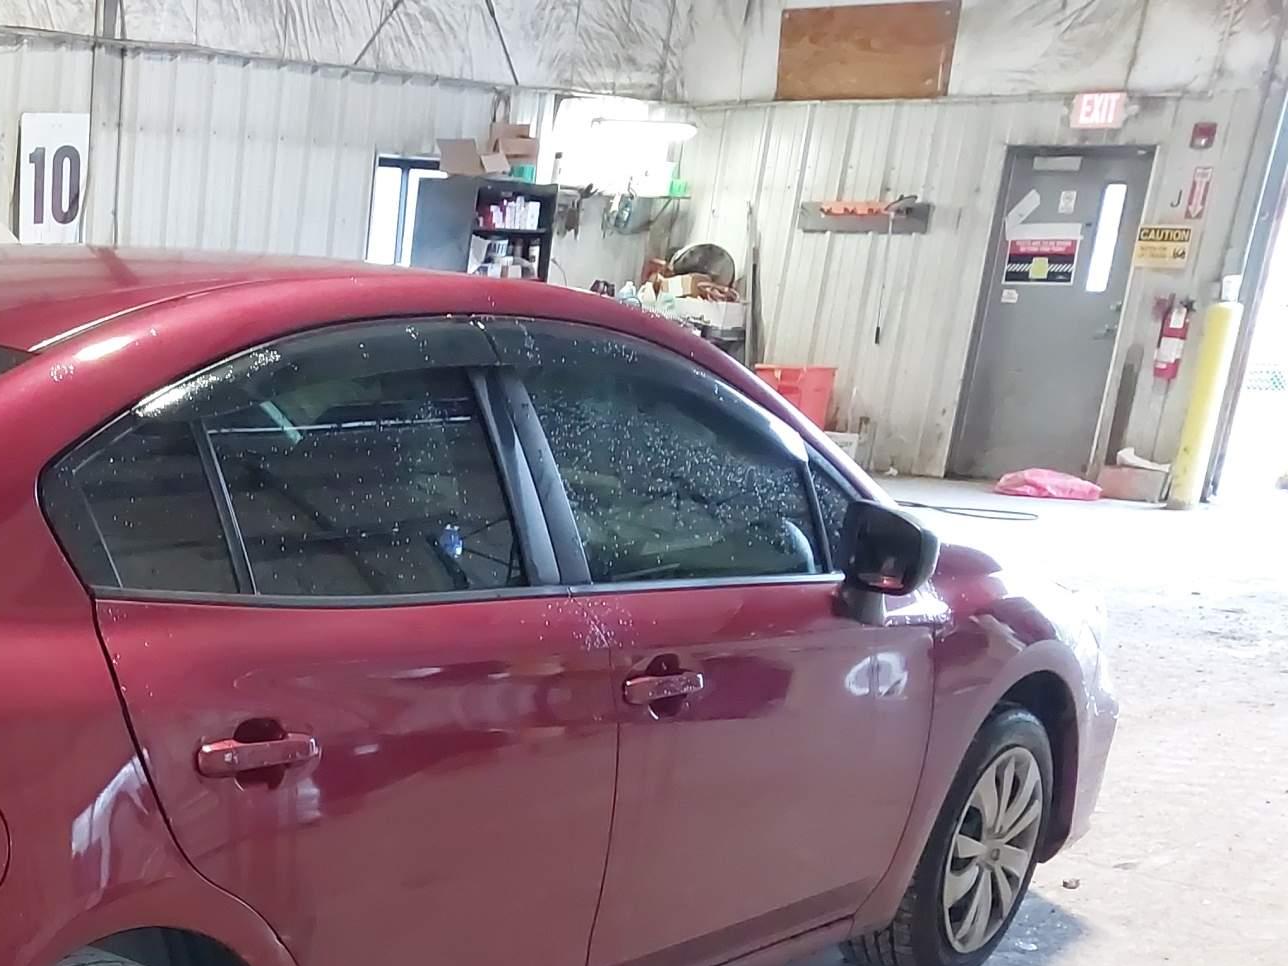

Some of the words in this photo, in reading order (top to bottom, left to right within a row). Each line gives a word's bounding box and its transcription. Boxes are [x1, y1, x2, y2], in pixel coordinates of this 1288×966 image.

[1080, 93, 1121, 124] EXIT
[29, 145, 81, 224] 10
[1140, 229, 1191, 241] CAUTION
